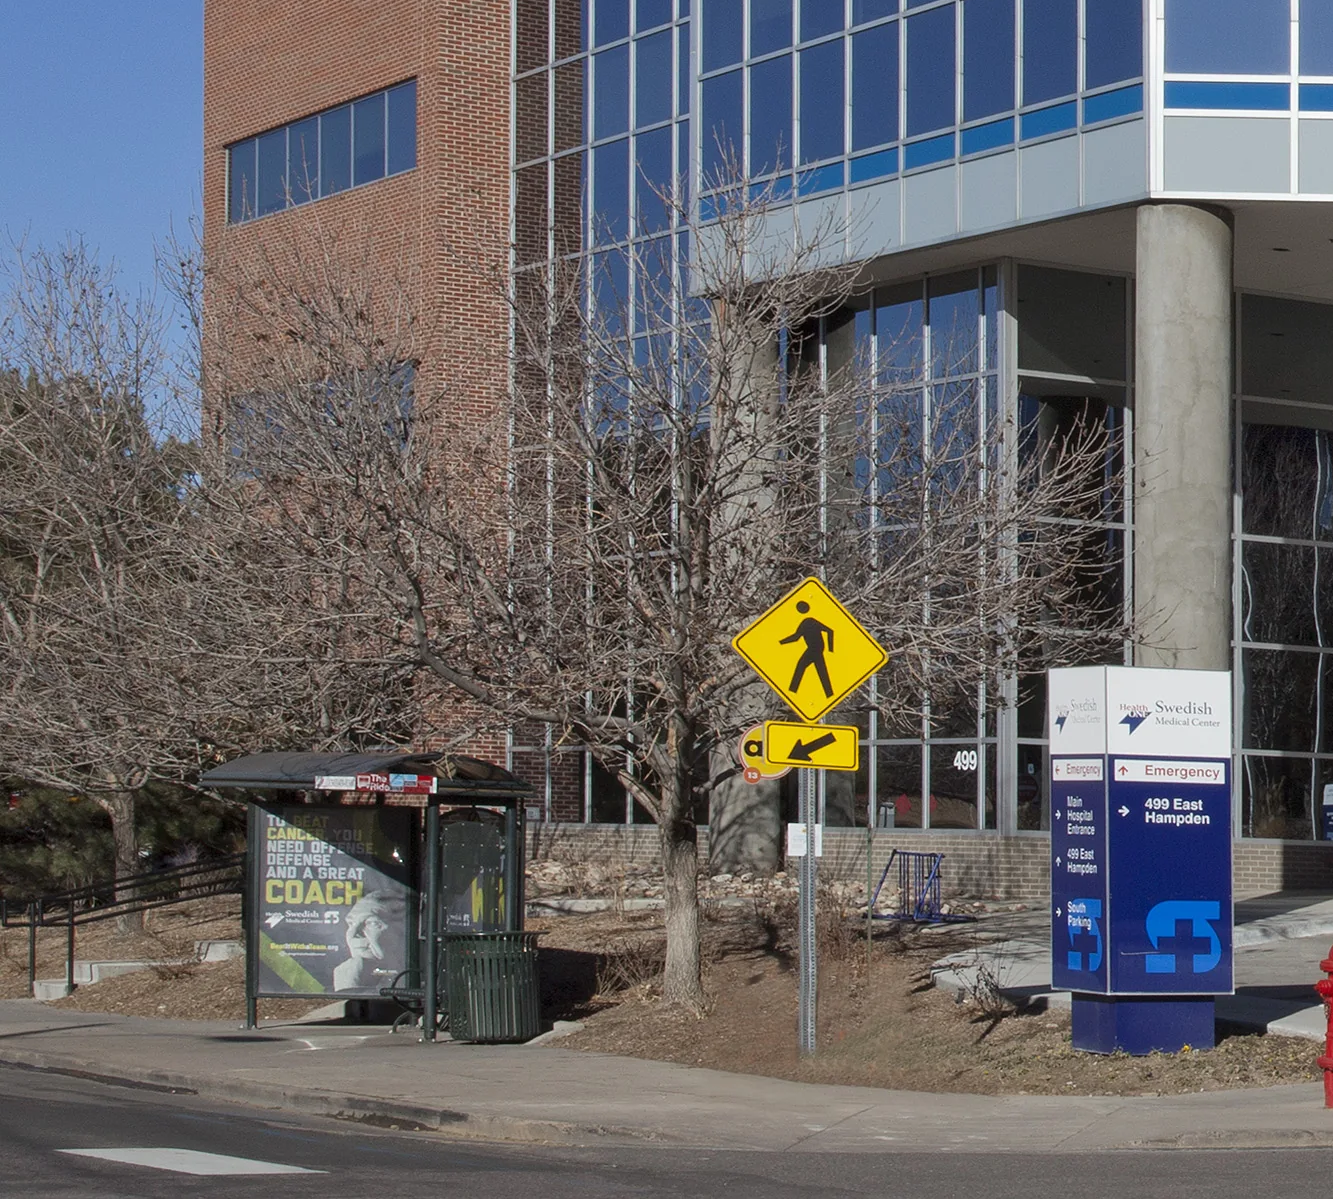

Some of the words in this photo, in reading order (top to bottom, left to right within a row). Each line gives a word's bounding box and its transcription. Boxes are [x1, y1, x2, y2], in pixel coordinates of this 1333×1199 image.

[1120, 703, 1149, 712] Health
[1155, 700, 1212, 715] Swedish
[1155, 717, 1190, 726] Medical
[1191, 718, 1220, 728] Center
[953, 750, 977, 771] 499
[747, 771, 758, 780] 13
[1066, 763, 1101, 777] Emergency
[1145, 764, 1220, 780] Emergency
[370, 774, 387, 784] The
[1067, 796, 1083, 807] Main
[1144, 798, 1170, 810] 499
[1173, 798, 1203, 811] East
[266, 814, 285, 827] TO
[1067, 809, 1093, 824] Hospital
[1145, 812, 1210, 826] Hampden
[333, 829, 362, 842] YOU
[1067, 823, 1095, 835] Entrance
[267, 840, 304, 853] NEED
[267, 853, 331, 867] DEFENSE
[1067, 848, 1079, 860] 499
[1080, 849, 1094, 860] East
[266, 866, 296, 879] AND
[303, 867, 313, 879] A
[318, 867, 365, 880] GREAT
[1067, 861, 1097, 875] Hampden
[265, 879, 363, 905] COACH
[1067, 901, 1086, 913] South
[285, 910, 319, 918] Swedish
[1067, 914, 1091, 930] Parking
